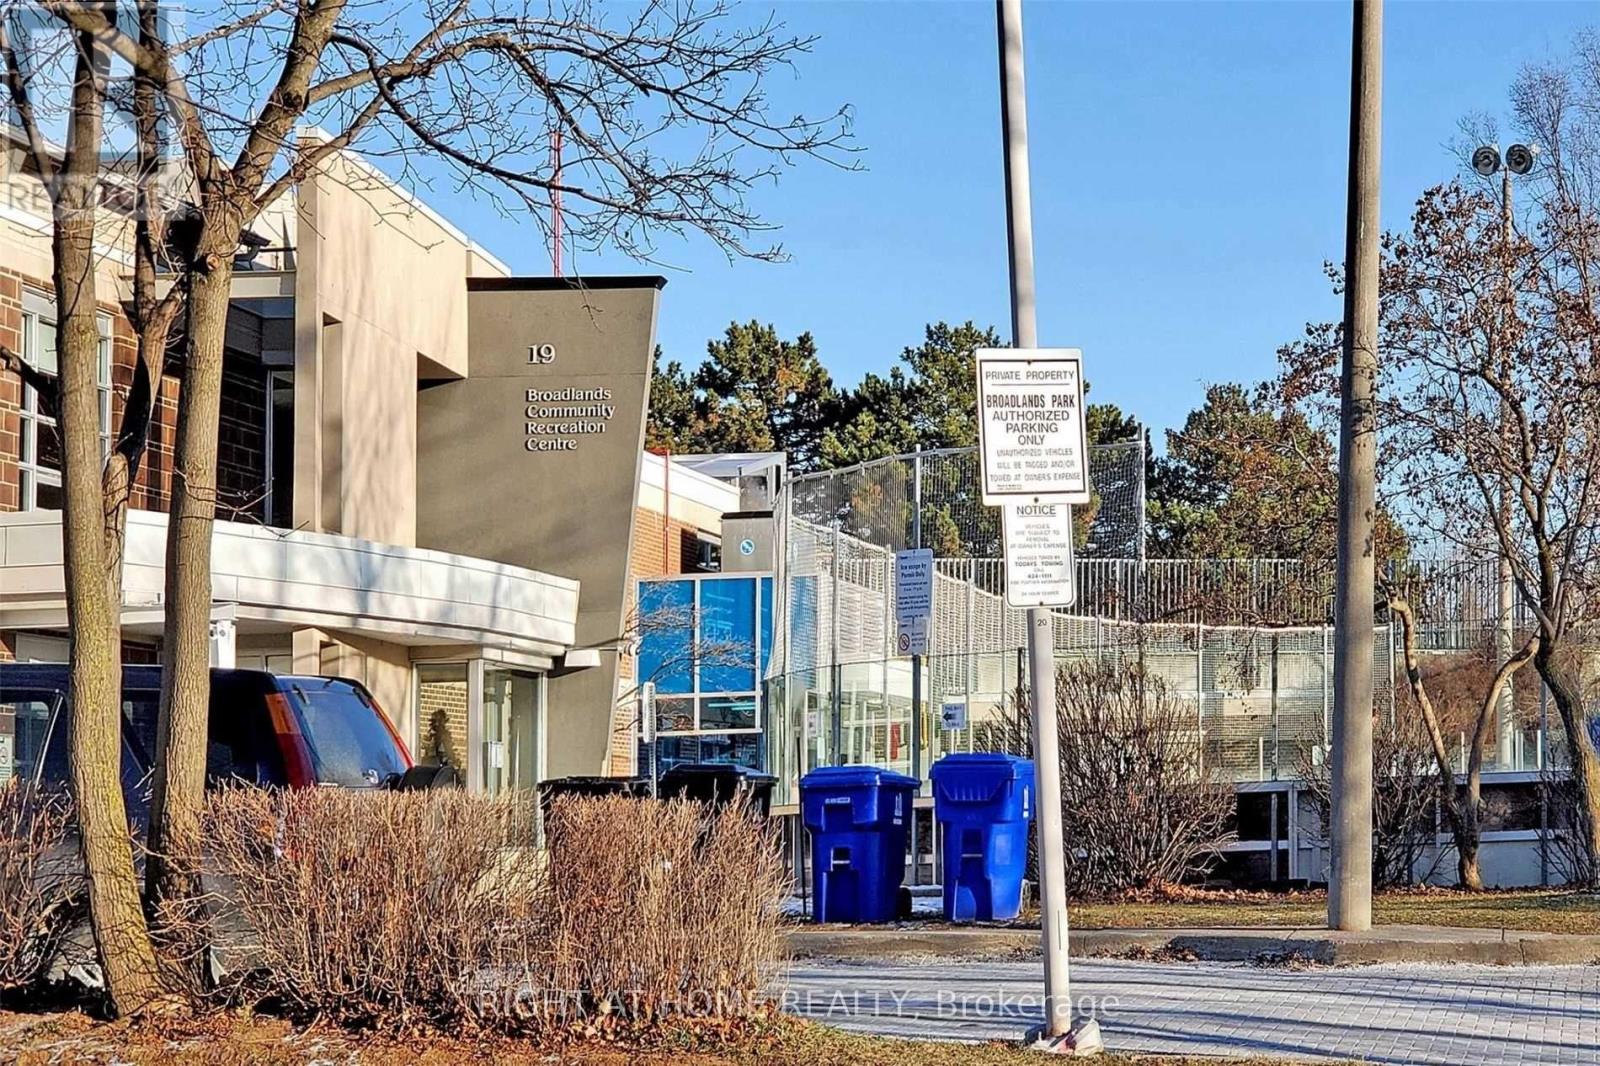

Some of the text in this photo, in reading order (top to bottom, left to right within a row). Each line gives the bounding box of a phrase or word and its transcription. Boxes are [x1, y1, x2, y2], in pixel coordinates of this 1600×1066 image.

[527, 344, 556, 365] 19
[986, 370, 1074, 381] PRIVATE PROPERTY
[526, 387, 612, 402] Broadlands
[986, 394, 1075, 408] BROADLANDS PARK
[525, 403, 616, 419] Community
[992, 410, 1070, 421] AUTHORIZED
[525, 420, 606, 435] Recreation
[1006, 422, 1058, 433] PARKING
[525, 437, 577, 451] Centre
[1018, 435, 1045, 446] ONLY
[1014, 461, 1022, 469] BE
[1025, 461, 1048, 469] TAGGED
[1051, 460, 1075, 468] AND/OR
[990, 474, 1011, 482] TOWED
[1054, 472, 1081, 480] EXPENSE
[1016, 505, 1056, 515] NOTICE
[1037, 618, 1048, 627] 20
